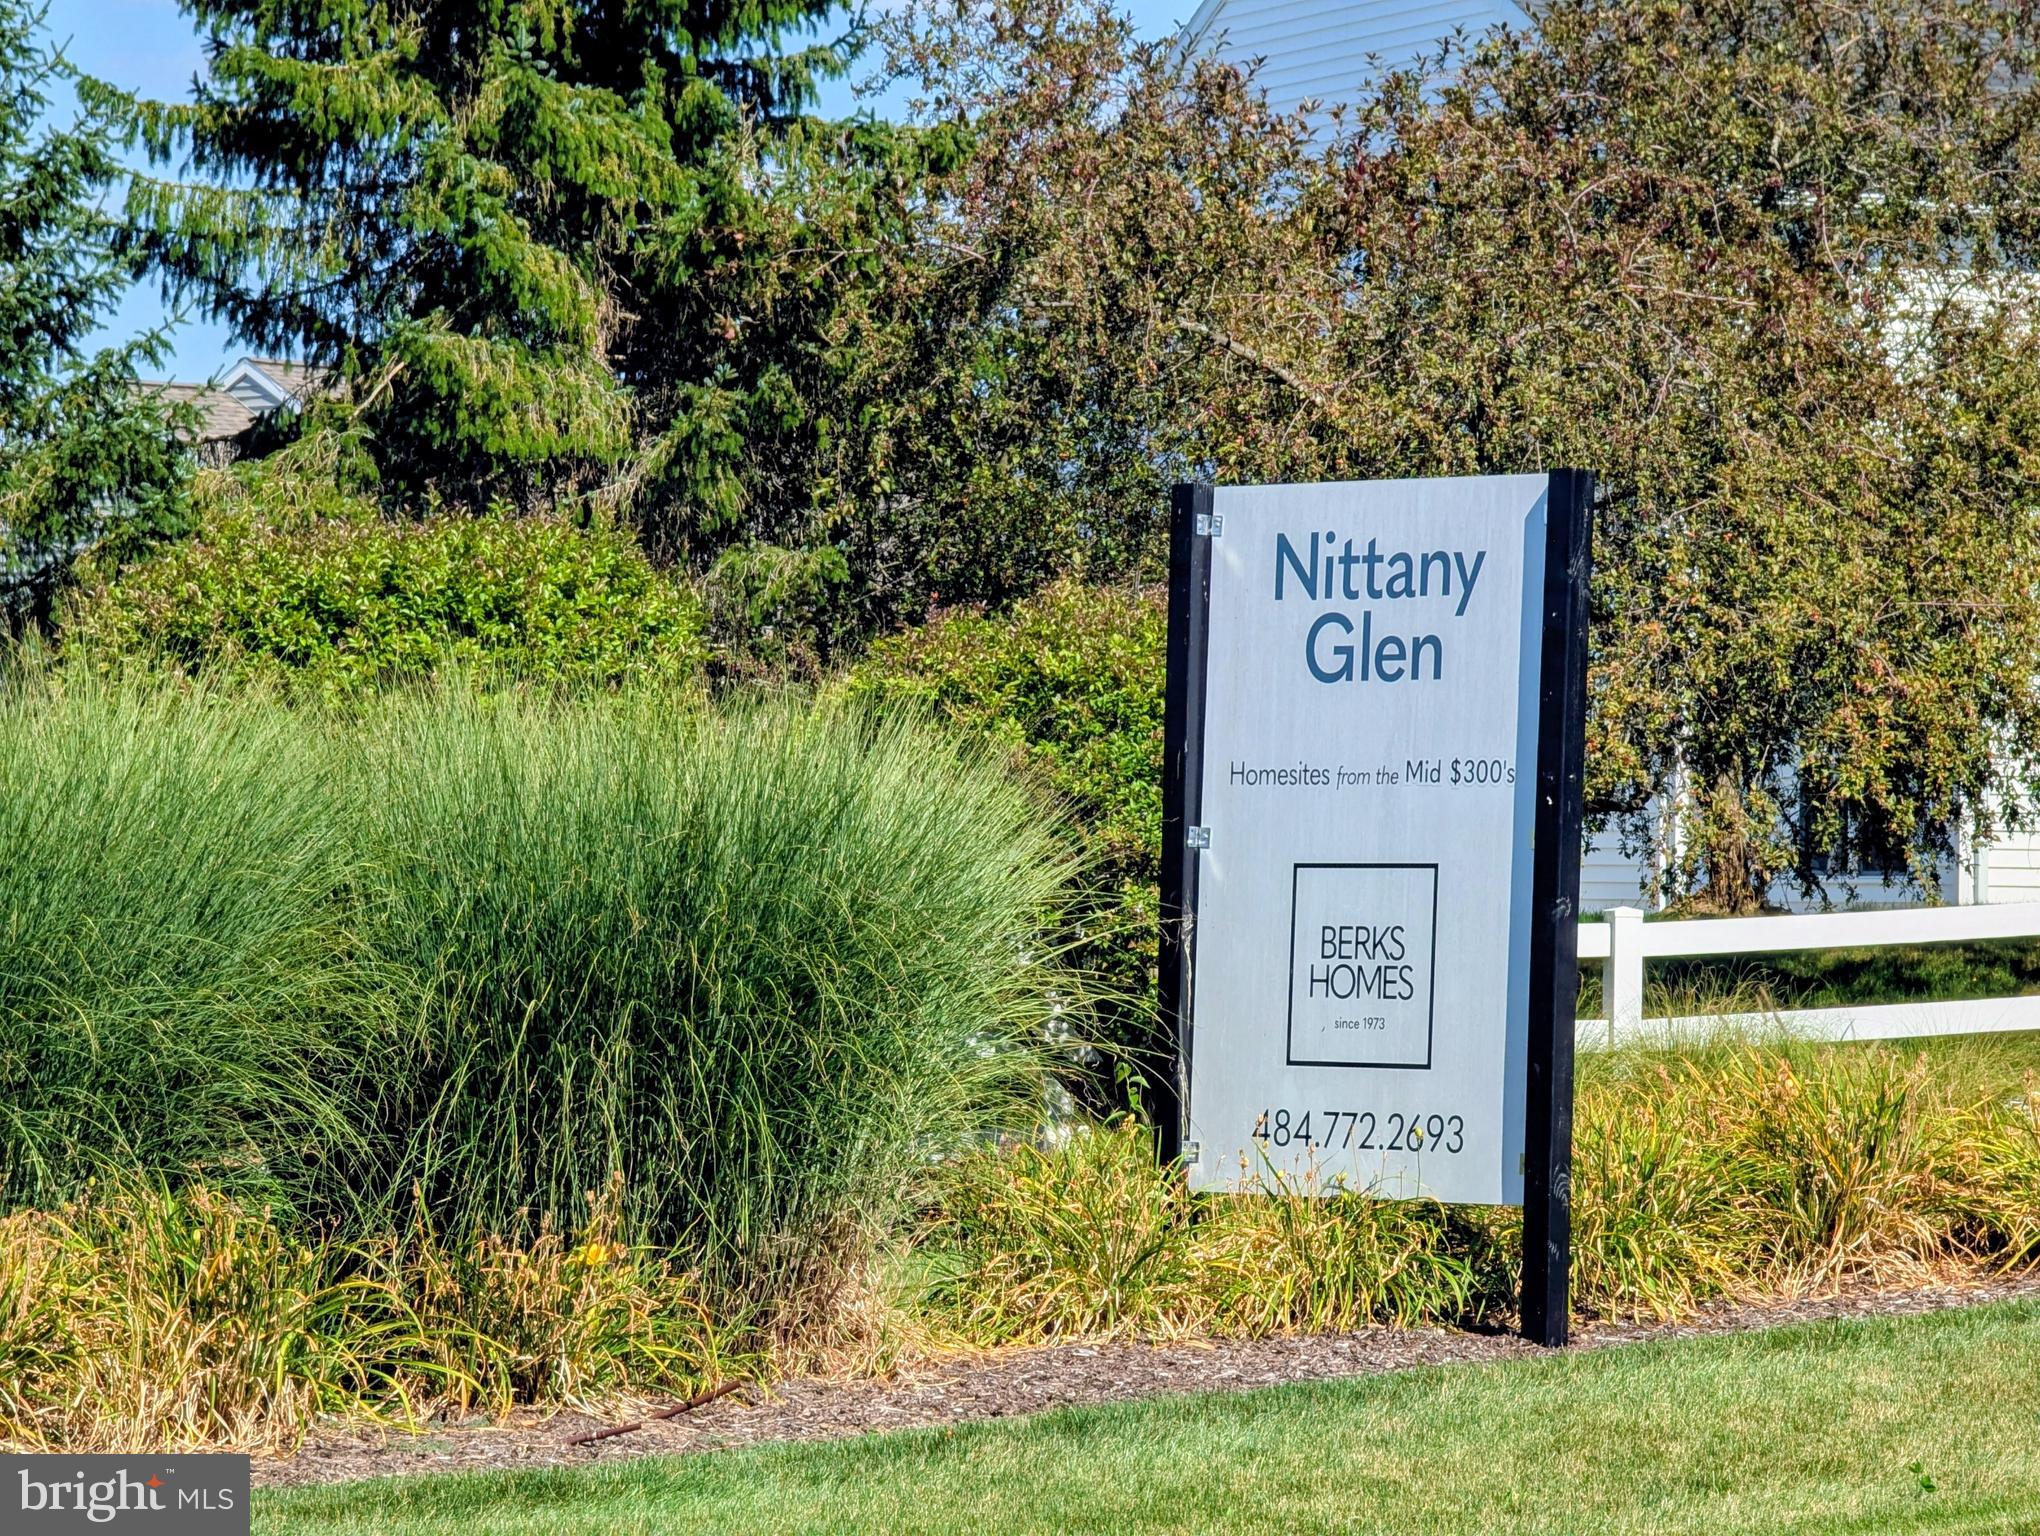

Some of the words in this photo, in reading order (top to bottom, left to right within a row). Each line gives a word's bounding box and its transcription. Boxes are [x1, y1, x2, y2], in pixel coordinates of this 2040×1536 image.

[1274, 531, 1487, 617] Nittany
[1305, 610, 1443, 684] Glen
[1230, 761, 1330, 786] Homesites
[1336, 766, 1371, 790] from
[1375, 765, 1399, 785] the
[1405, 758, 1441, 784] Mid
[1450, 757, 1516, 786] $300's
[1320, 925, 1406, 961] BERKS
[1309, 963, 1414, 1000] HOMES
[1334, 1017, 1360, 1030] since
[1362, 1016, 1386, 1030] 1973
[1252, 1109, 1465, 1154] 484.772.2693
